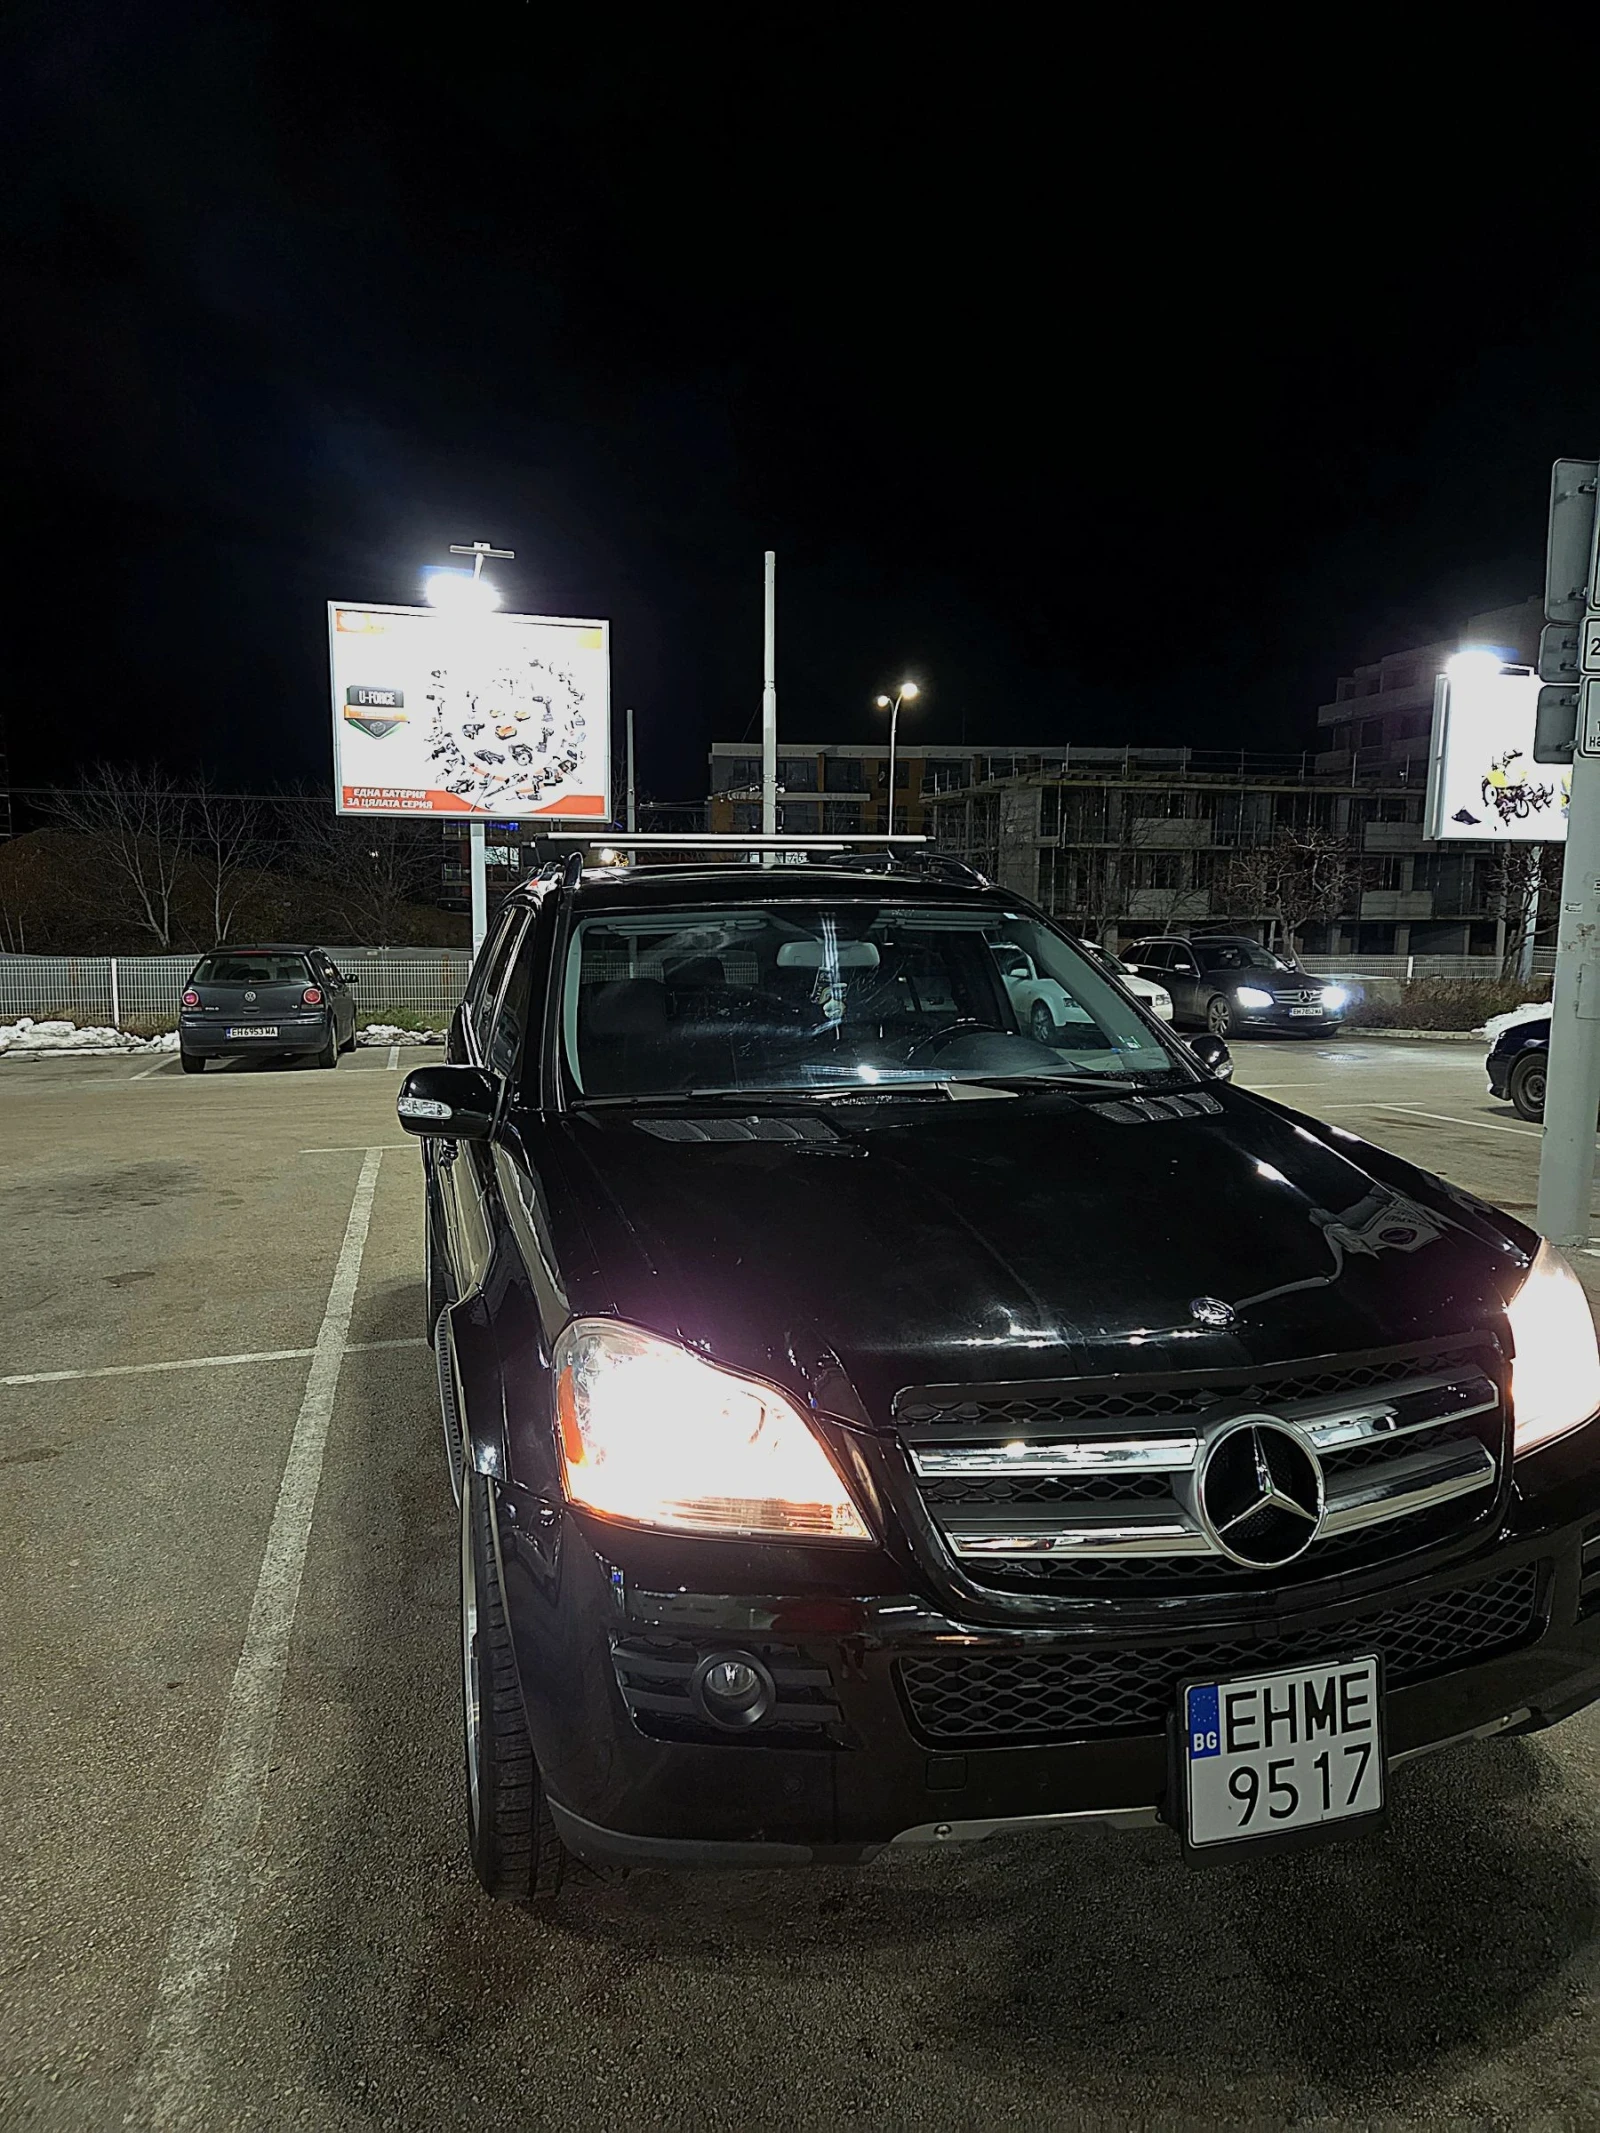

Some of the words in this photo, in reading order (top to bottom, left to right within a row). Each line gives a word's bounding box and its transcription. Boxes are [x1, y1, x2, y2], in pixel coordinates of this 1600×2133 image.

[358, 690, 395, 705] U-FORCE
[353, 788, 381, 798] ЕДНА
[381, 788, 426, 799] БАТЕРИЯ
[347, 797, 359, 806] ЗА
[361, 798, 400, 808] ЦЯЛАТА
[401, 800, 433, 809] СЕРИЯ
[1225, 1669, 1372, 1754] EHME
[1193, 1731, 1218, 1752] BG
[1228, 1742, 1372, 1827] 9517
